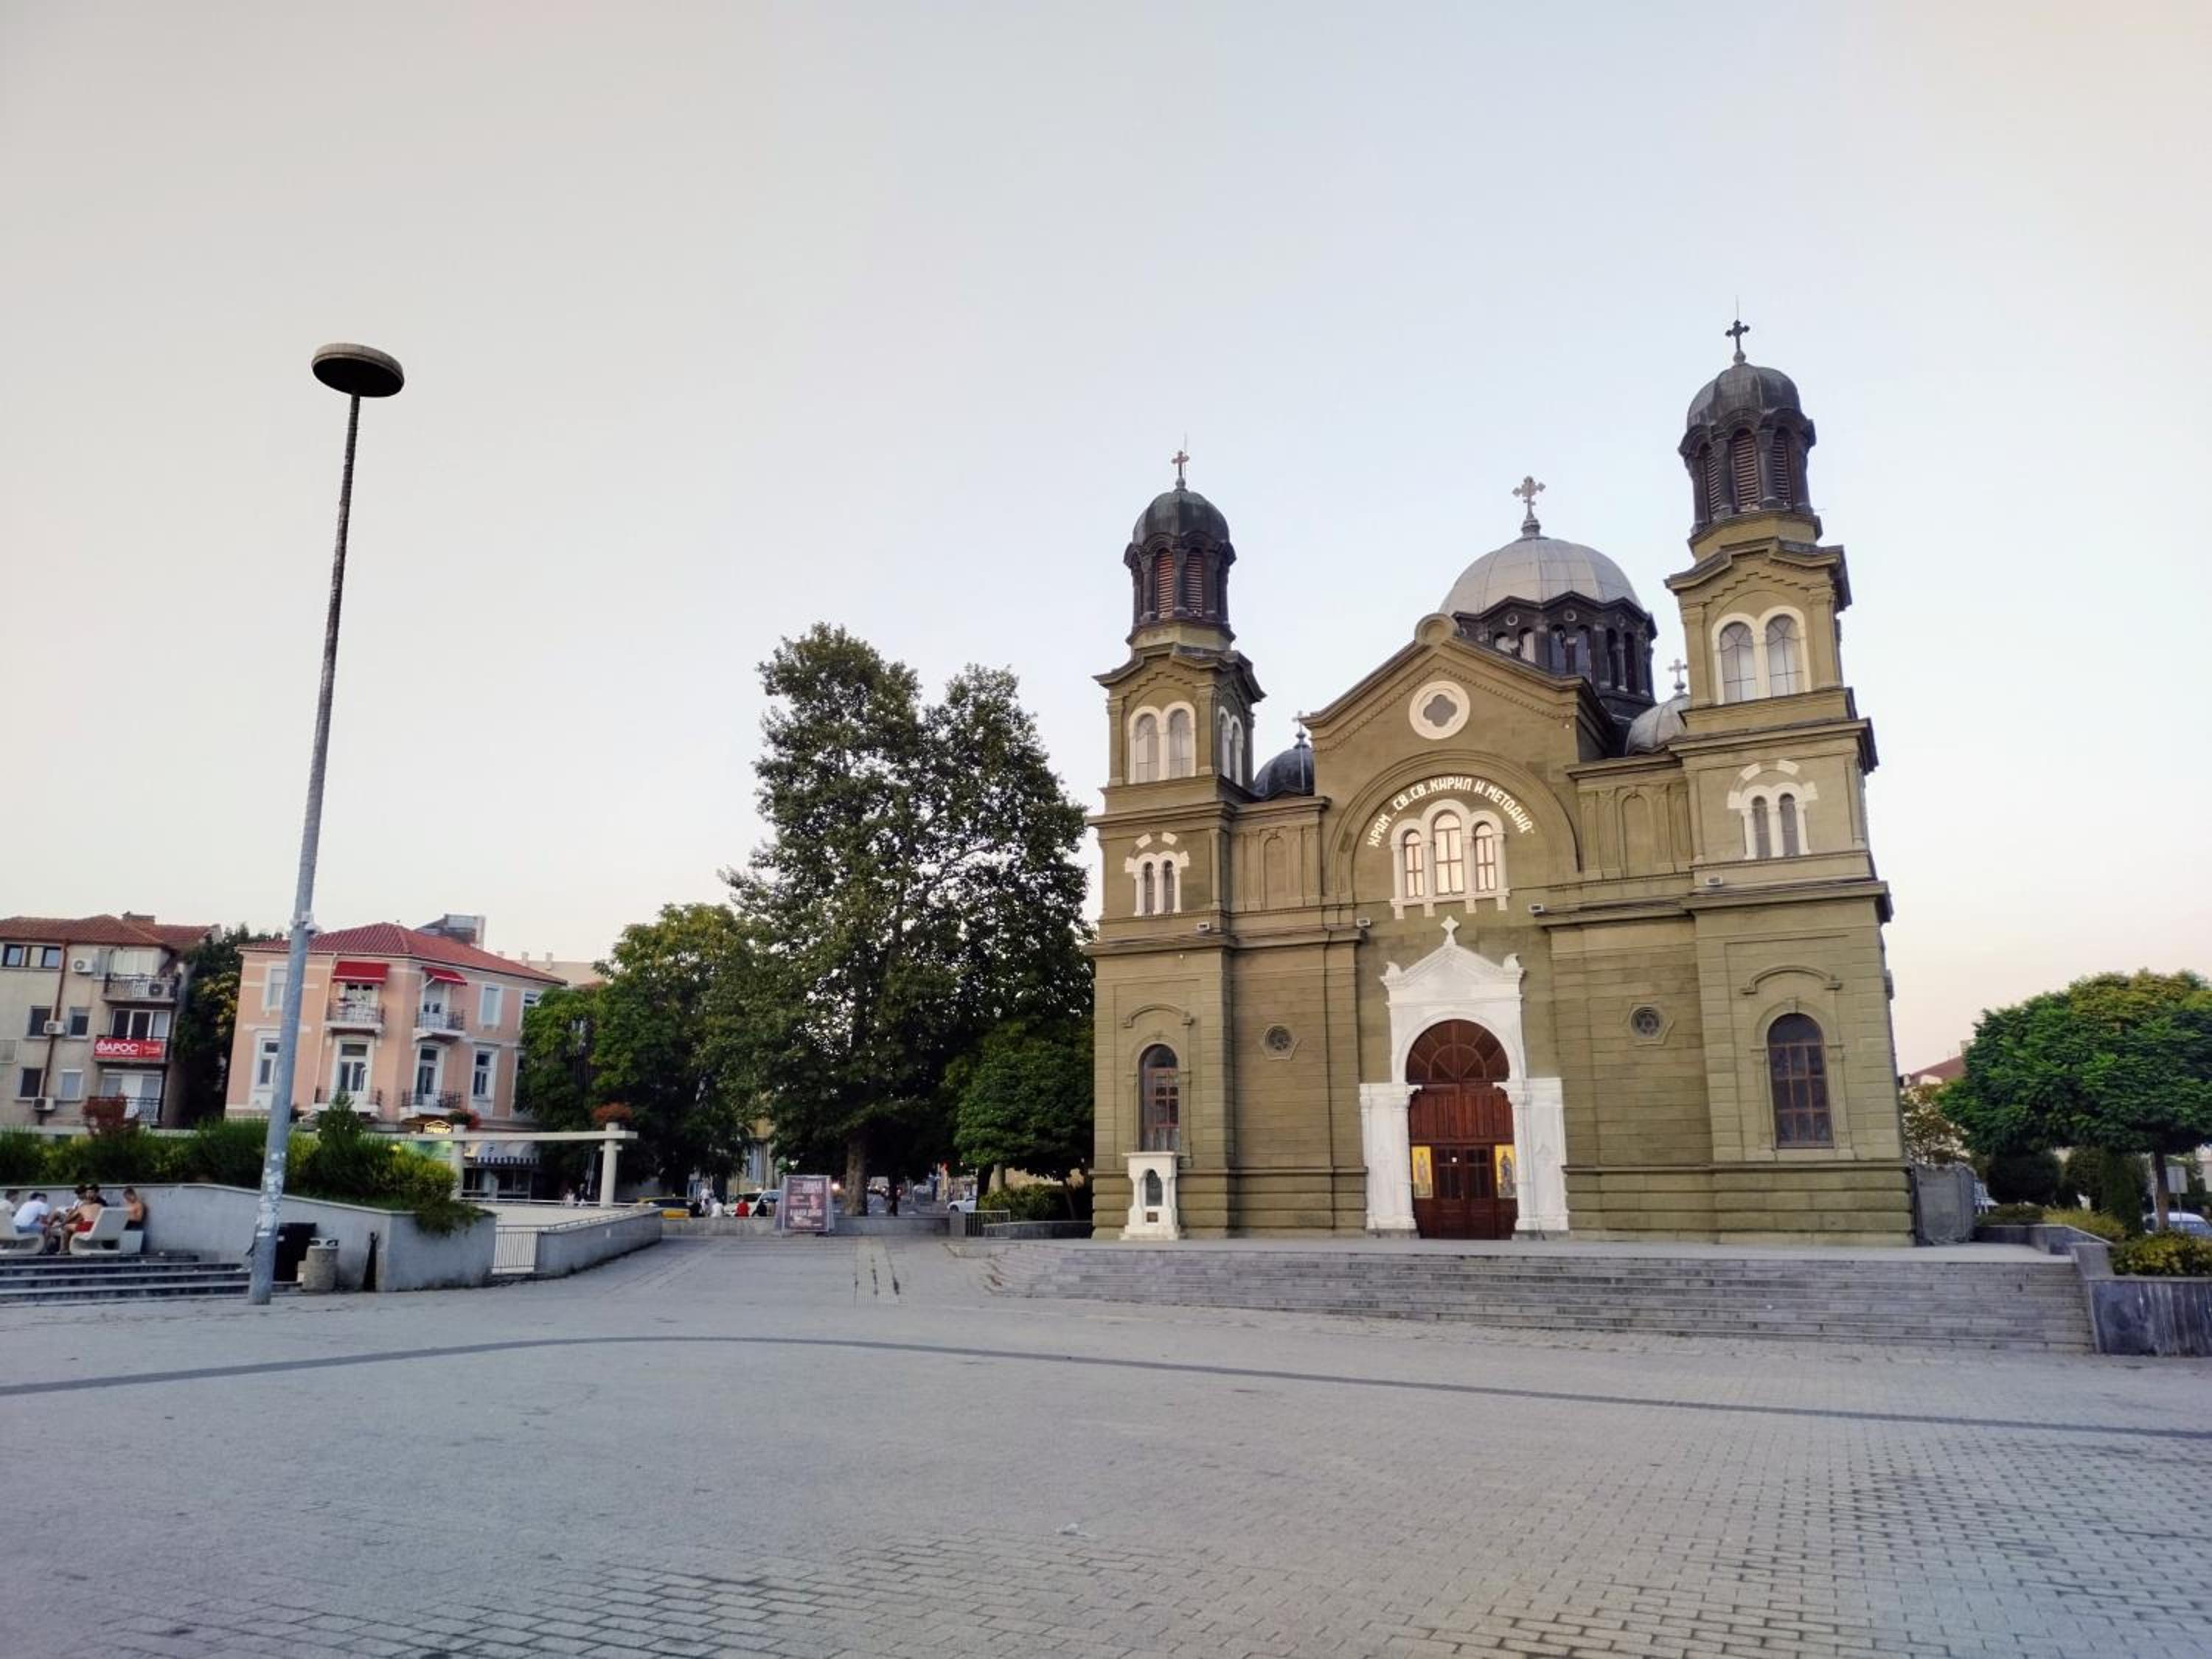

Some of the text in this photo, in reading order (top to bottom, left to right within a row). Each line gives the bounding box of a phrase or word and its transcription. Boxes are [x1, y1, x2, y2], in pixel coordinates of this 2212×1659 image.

[1367, 813, 1391, 847] ХРАМ
[1430, 776, 1472, 792] КИРИЛ
[1474, 780, 1485, 794] И
[96, 1040, 139, 1052] ФАРОС
